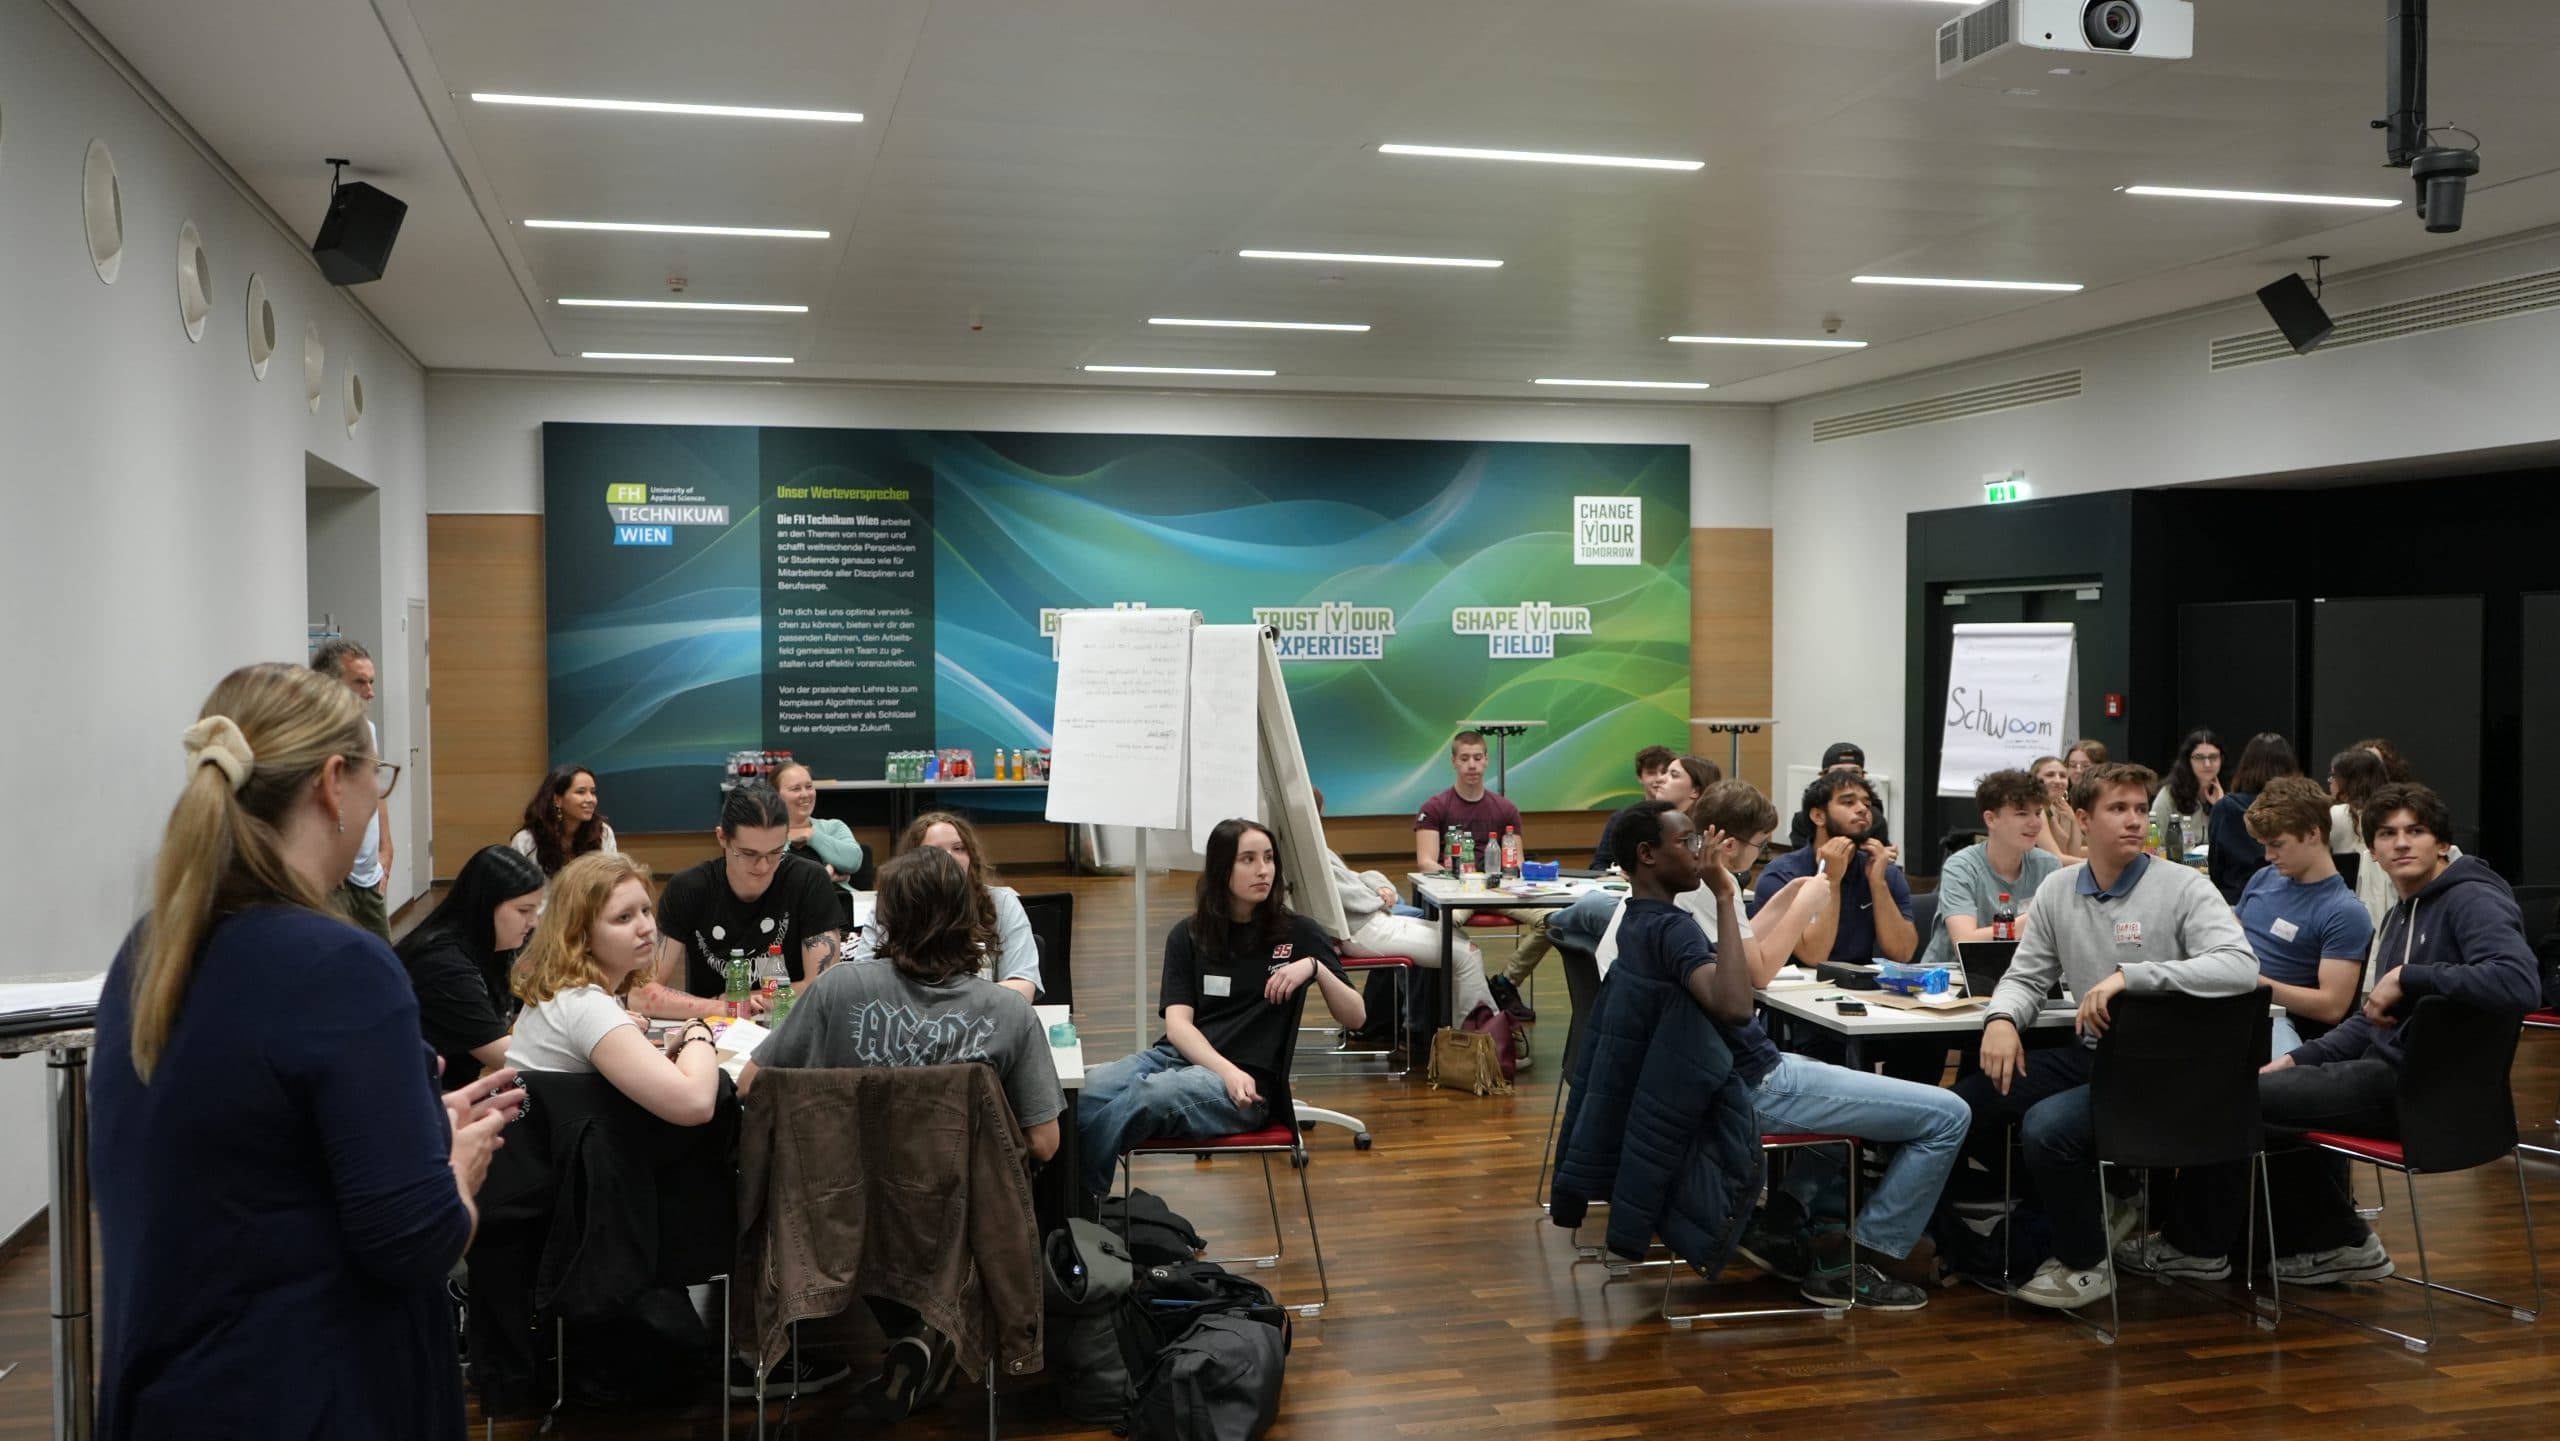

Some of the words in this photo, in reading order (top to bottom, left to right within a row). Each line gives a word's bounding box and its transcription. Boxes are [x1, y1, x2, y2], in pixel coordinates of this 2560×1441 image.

[618, 488, 640, 500] FH
[650, 487, 685, 495] University
[777, 486, 808, 498] Unser
[810, 486, 909, 501] Werteversprechen
[618, 507, 723, 522] TECHNIKUM
[1581, 504, 1634, 519] CHANGE
[777, 514, 792, 524] Die
[794, 515, 805, 525] FH
[807, 515, 855, 525] Technikum
[856, 515, 879, 525] Wien
[620, 527, 667, 542] WIEN
[808, 530, 840, 538] Themen
[859, 531, 889, 540] morgen
[777, 543, 805, 551] schafft
[865, 544, 915, 552] Perspektiven
[1581, 547, 1634, 558] TOMORROW
[791, 556, 839, 564] Studierende
[842, 557, 876, 566] genauso
[778, 569, 833, 577] Mitarbeitende
[835, 569, 852, 577] aller
[854, 570, 896, 579] Disziplinen
[899, 570, 913, 578] und
[778, 582, 828, 591] Berufswege.
[779, 608, 793, 616] Um
[795, 608, 812, 616] dich
[814, 608, 827, 616] bei
[846, 608, 875, 617] optimal
[877, 608, 912, 616] verwirkli-
[779, 621, 798, 629] chen
[813, 621, 844, 630] können,
[846, 621, 871, 629] bieten
[873, 621, 885, 629] wir
[887, 621, 898, 629] dir
[899, 621, 914, 629] den
[1257, 611, 1319, 631] TRUST
[1456, 611, 1518, 631] SHAPE
[779, 634, 823, 643] passenden
[825, 634, 860, 642] Rahmen,
[882, 634, 912, 642] Arbeits-
[1276, 636, 1379, 655] XPERTISE!
[1492, 635, 1550, 655] FIELD!
[796, 647, 842, 656] gemeinsam
[891, 648, 904, 656] ge-
[779, 660, 806, 668] stalten
[808, 660, 823, 668] und
[826, 660, 854, 668] effektiv
[856, 660, 916, 668] voranzutreiben.
[779, 686, 794, 694] Von
[797, 686, 810, 694] der
[812, 686, 860, 695] praxisnahen
[887, 685, 898, 693] bis
[779, 699, 823, 708] komplexen
[825, 699, 874, 708] Algorithmus:
[779, 712, 823, 720] Know-how
[851, 711, 863, 719] wir
[865, 711, 876, 719] als
[878, 710, 916, 718] Schlüssel
[811, 724, 858, 733] erfolgreiche
[860, 724, 892, 732] Zukunft.
[1272, 944, 1293, 958] 95
